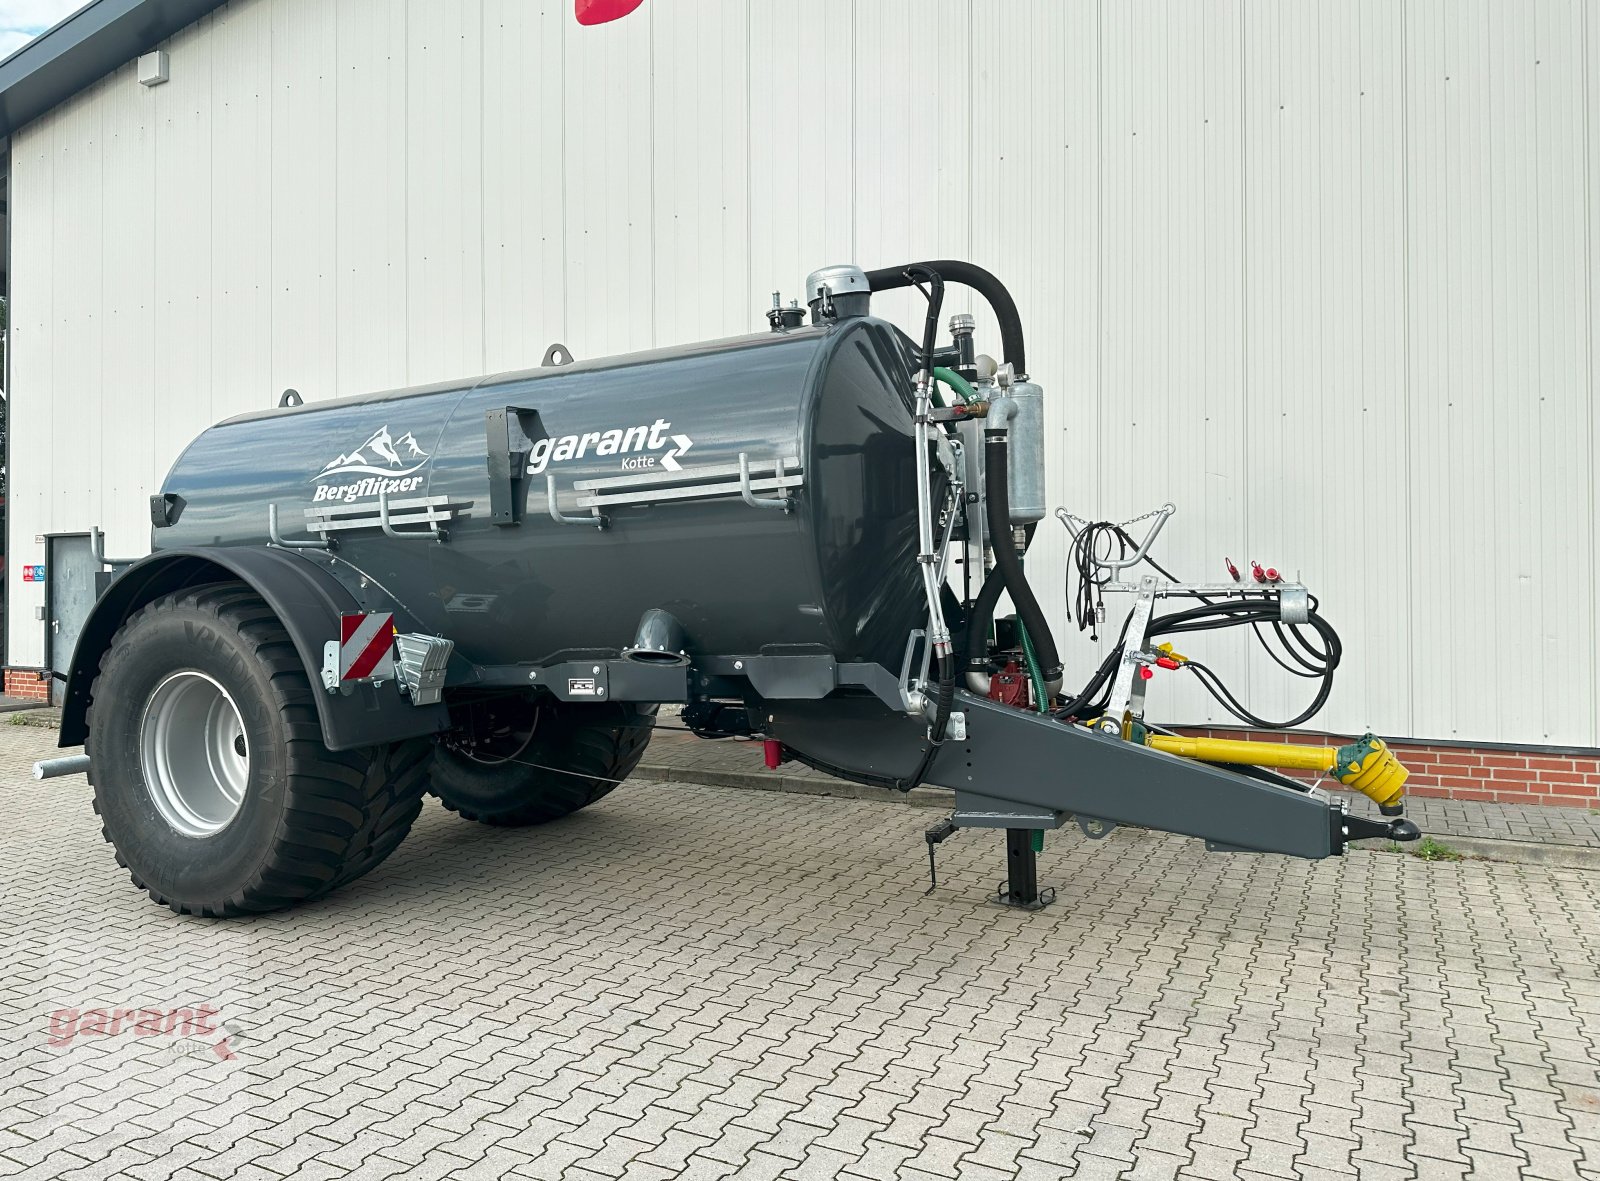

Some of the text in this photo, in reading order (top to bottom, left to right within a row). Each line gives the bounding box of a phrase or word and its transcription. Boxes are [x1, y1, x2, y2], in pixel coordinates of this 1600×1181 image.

[526, 418, 671, 475] garant
[621, 455, 655, 470] Kotte
[313, 475, 424, 503] Bergflitzer
